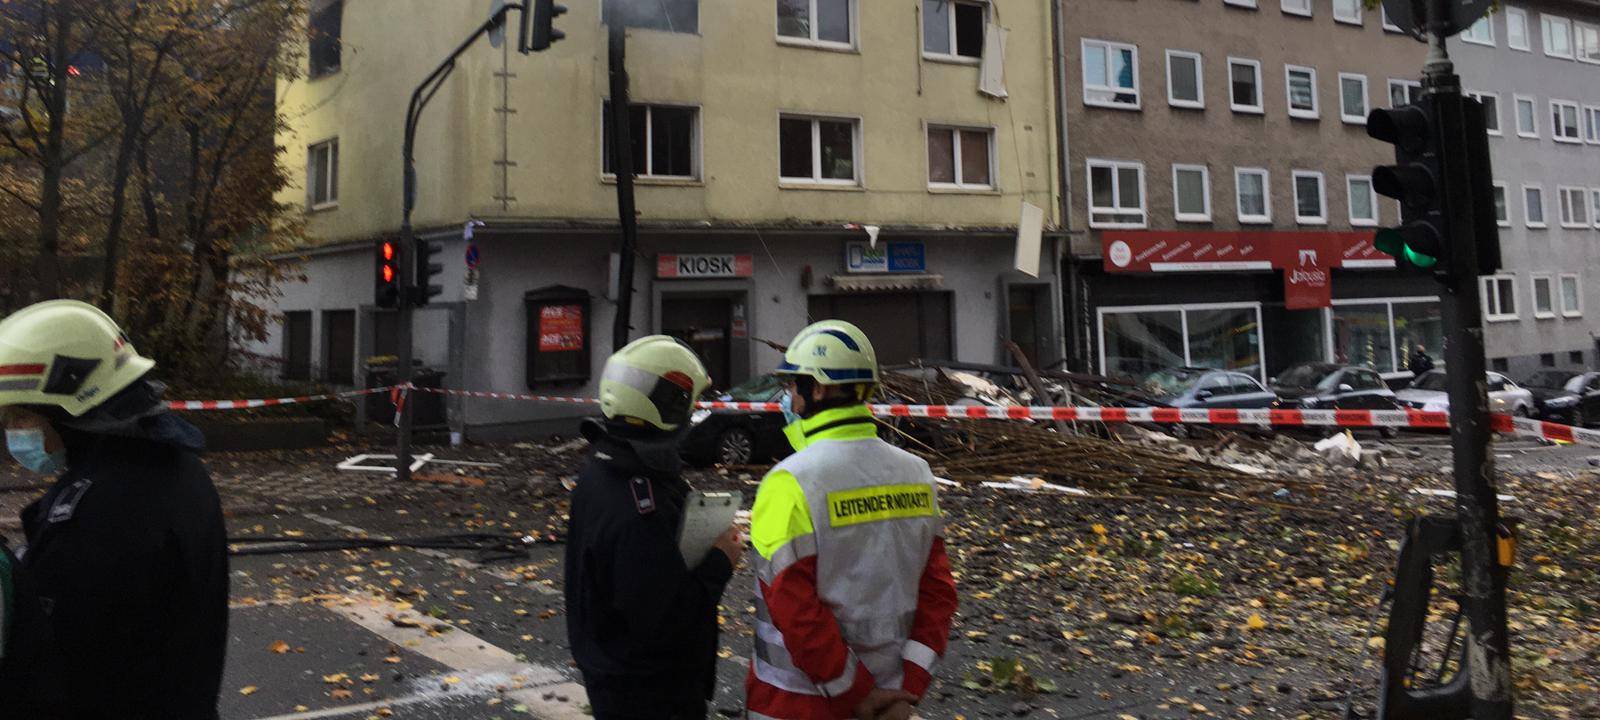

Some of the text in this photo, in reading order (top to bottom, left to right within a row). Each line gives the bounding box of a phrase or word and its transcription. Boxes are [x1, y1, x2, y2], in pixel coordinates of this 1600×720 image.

[679, 256, 733, 274] KIOSK
[834, 492, 930, 518] LEITENDER NOTARZT
